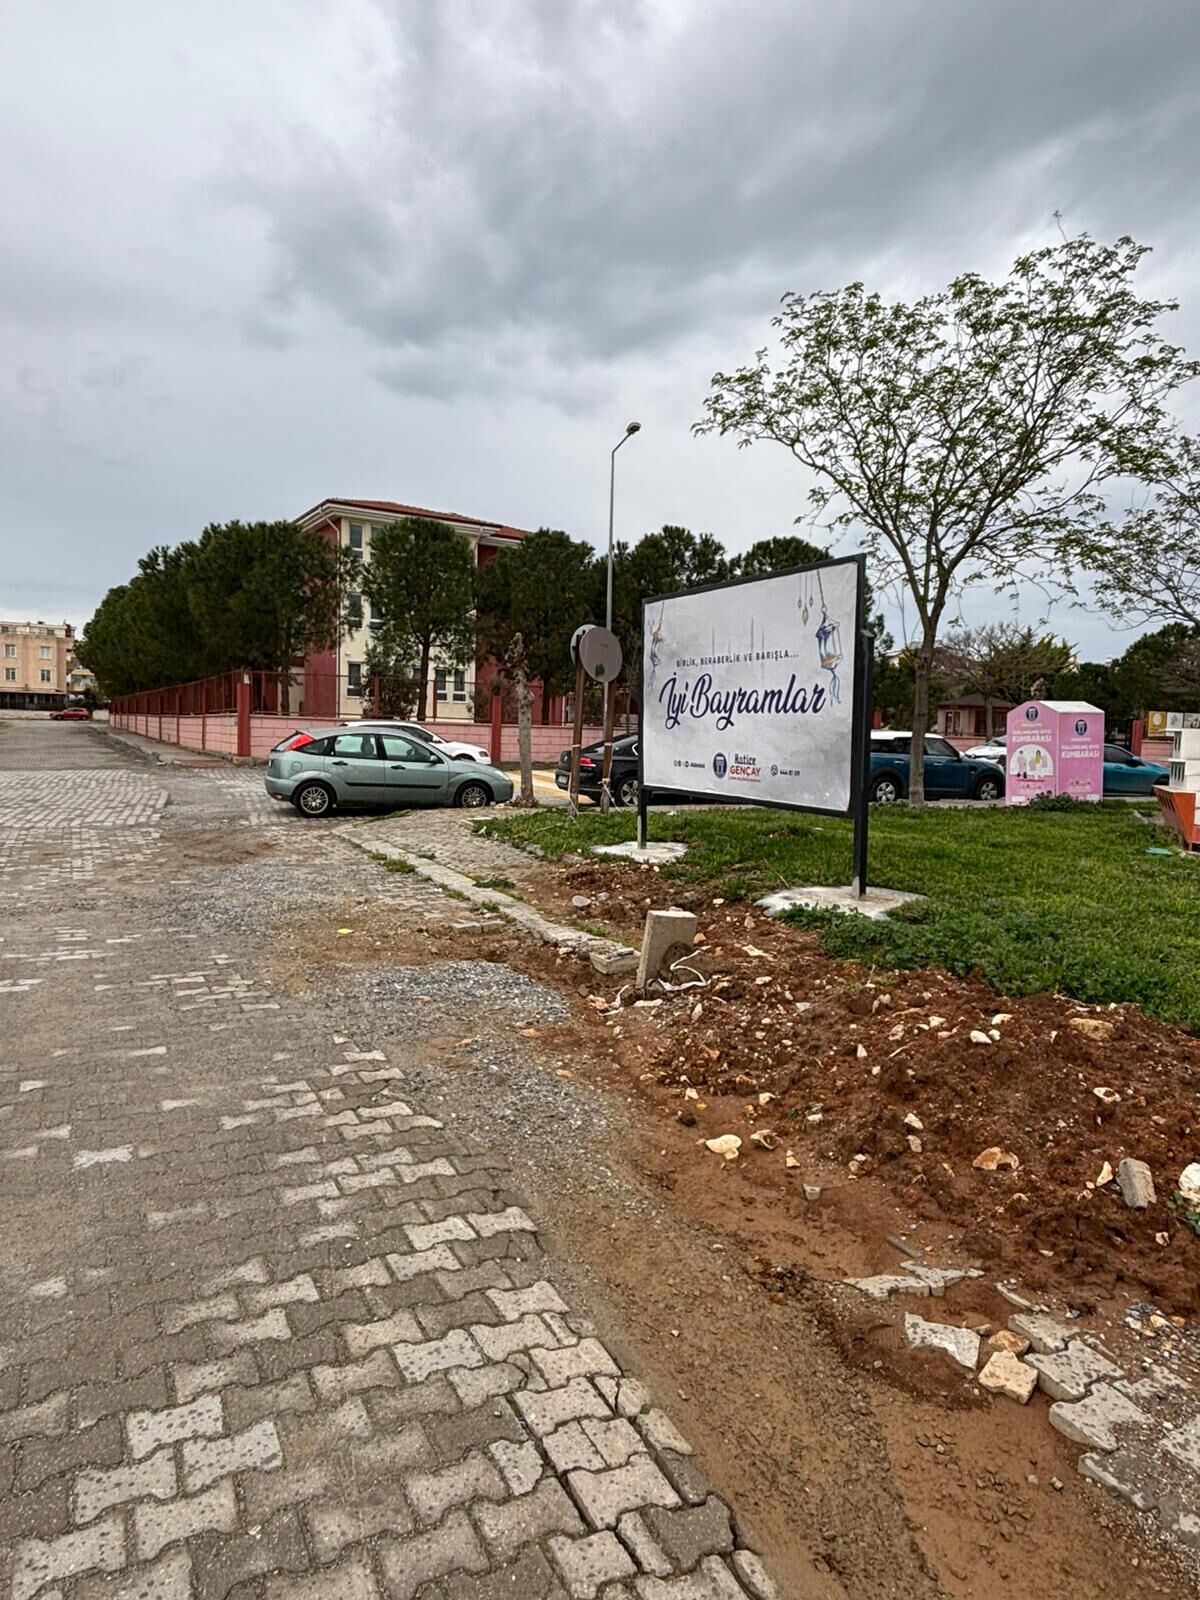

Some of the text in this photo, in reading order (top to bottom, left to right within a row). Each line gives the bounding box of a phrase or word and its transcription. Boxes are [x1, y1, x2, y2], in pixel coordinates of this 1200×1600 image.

[676, 657, 698, 668] BİRLİK,
[700, 653, 741, 666] BERABERLİK
[743, 652, 753, 662] VE
[689, 672, 826, 731] Bayramlar
[730, 764, 761, 777] GENÇAY
